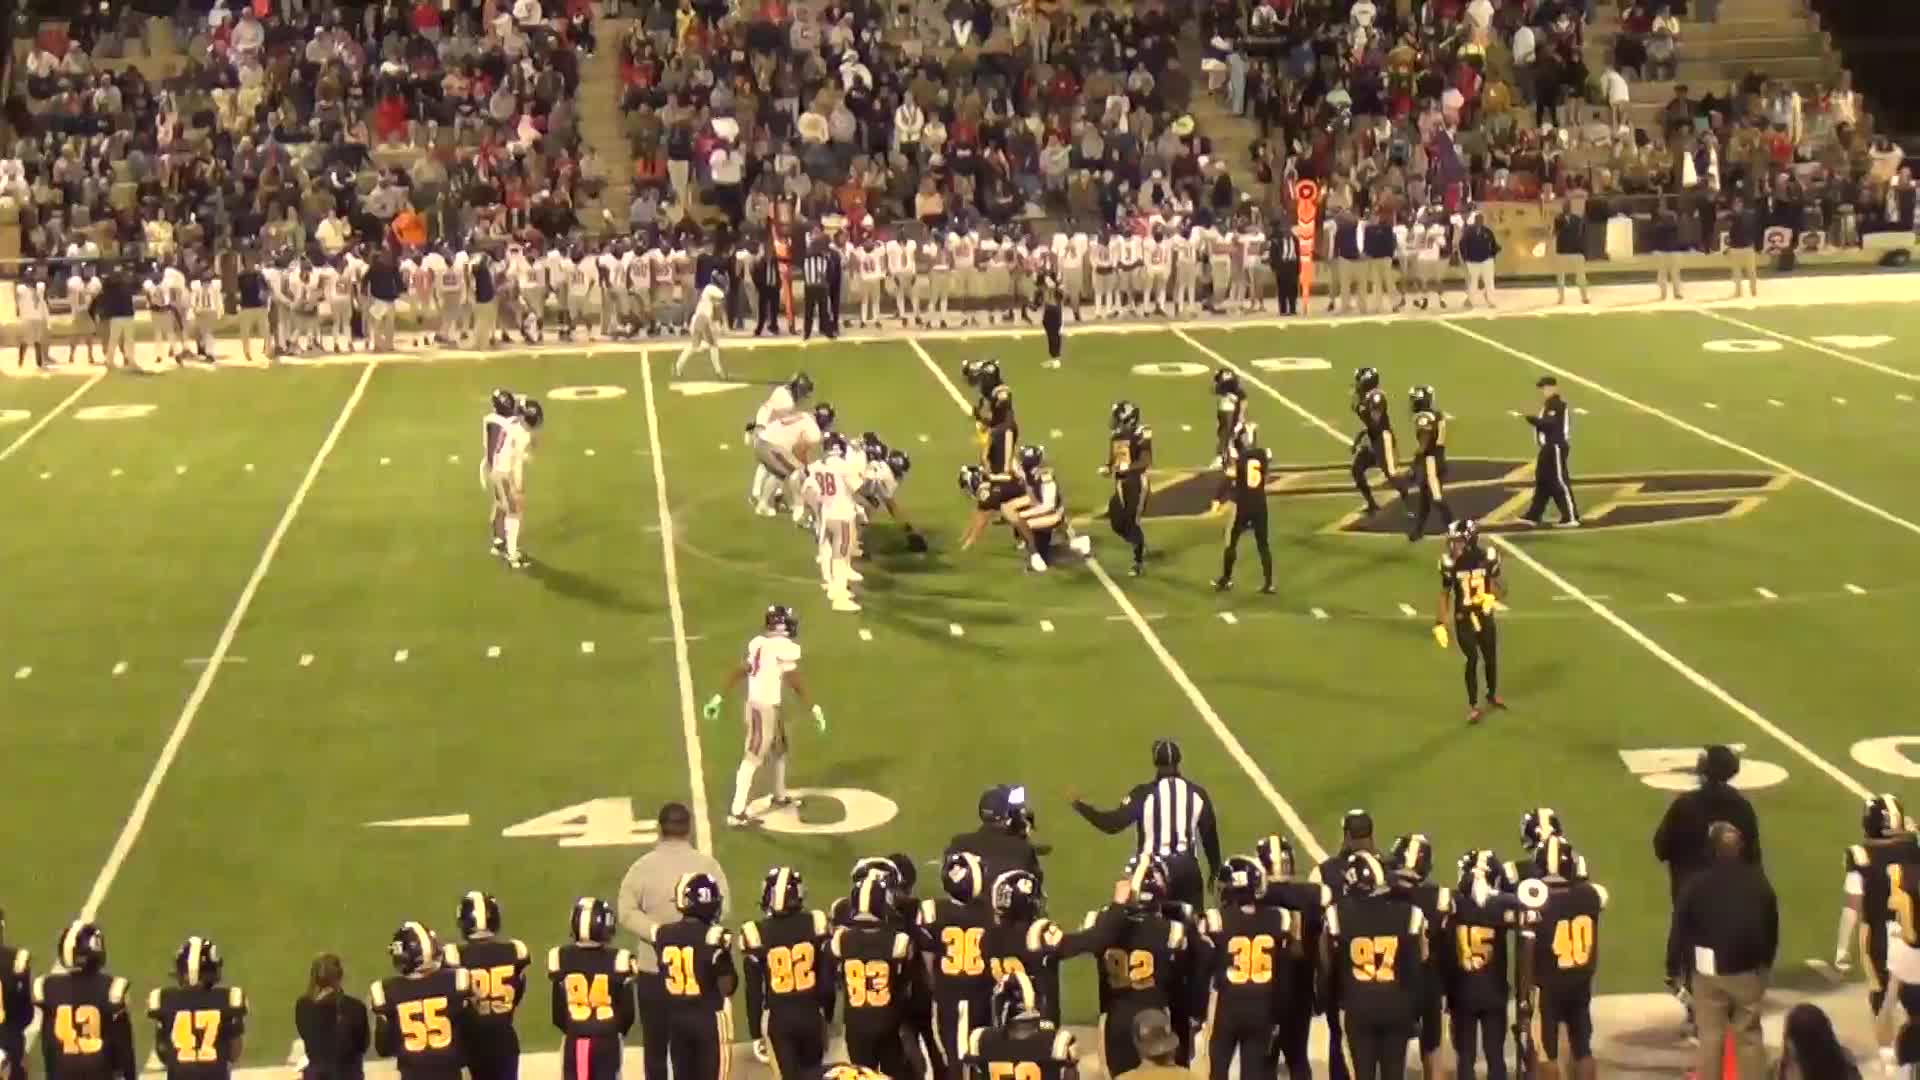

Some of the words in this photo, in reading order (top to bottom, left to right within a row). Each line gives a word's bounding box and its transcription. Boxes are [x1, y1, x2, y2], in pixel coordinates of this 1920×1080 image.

[1246, 459, 1262, 489] 6
[1226, 933, 1275, 984] 36
[1349, 935, 1399, 982] 97
[1455, 924, 1496, 972] 15
[1552, 914, 1594, 968] 40
[662, 945, 702, 996] 31
[767, 941, 816, 994] 82
[843, 958, 891, 1007] 83
[54, 1004, 103, 1055] 43
[171, 1009, 222, 1064] 47
[397, 997, 453, 1053] 55
